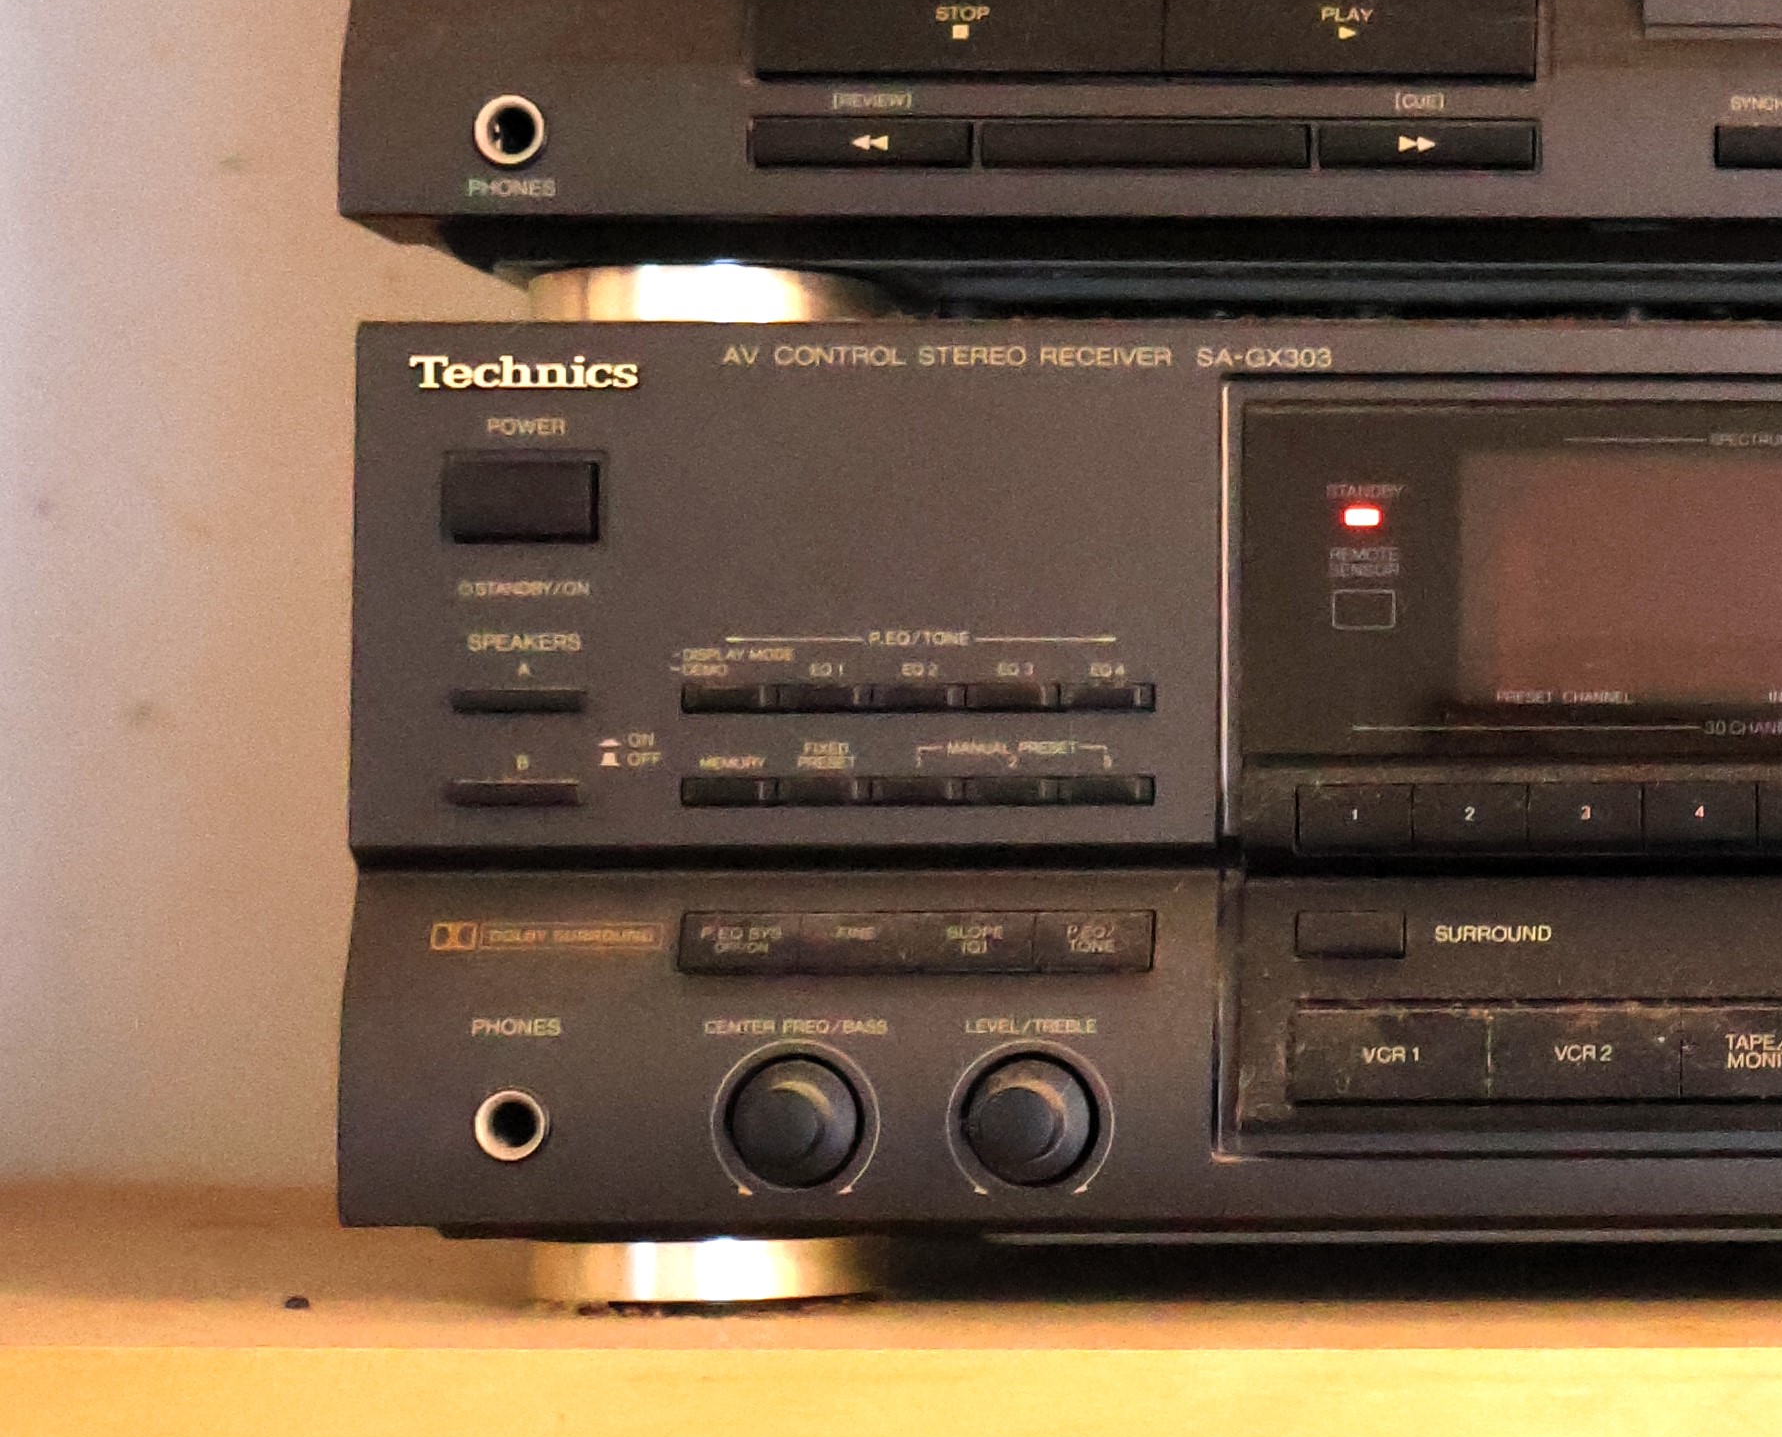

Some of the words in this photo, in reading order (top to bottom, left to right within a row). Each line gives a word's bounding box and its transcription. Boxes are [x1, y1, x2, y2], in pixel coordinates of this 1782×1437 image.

[935, 5, 990, 21] STOP
[1321, 9, 1373, 22] PLAY
[467, 178, 556, 197] PHONES
[724, 347, 761, 365] AV
[774, 347, 905, 366] CONTROL
[918, 347, 1028, 366] STEREO
[1040, 347, 1172, 366] RECEIVER
[1196, 347, 1333, 369] SA-GX303
[409, 355, 639, 392] Technics
[486, 417, 566, 436] POWER
[1329, 547, 1399, 562] REMOTE
[1329, 563, 1399, 577] SENSOR
[467, 633, 582, 652] SPEAKERS
[517, 663, 530, 677] A
[1497, 690, 1552, 704] PRESET
[1562, 691, 1633, 705] CHANNEL
[627, 732, 655, 748] ON
[627, 752, 661, 767] OFF
[1464, 806, 1475, 821] 2
[1581, 805, 1591, 820] 3
[1694, 805, 1705, 819] 4
[1435, 925, 1552, 943] SURROUND
[471, 1019, 562, 1037] PHONES
[704, 1020, 775, 1034] CENTER
[965, 1019, 1097, 1034] LEVEL/TREBLE
[1363, 1047, 1405, 1063] VCR
[1413, 1047, 1420, 1061] 1
[1554, 1044, 1597, 1062] VCR
[1600, 1045, 1612, 1061] 2
